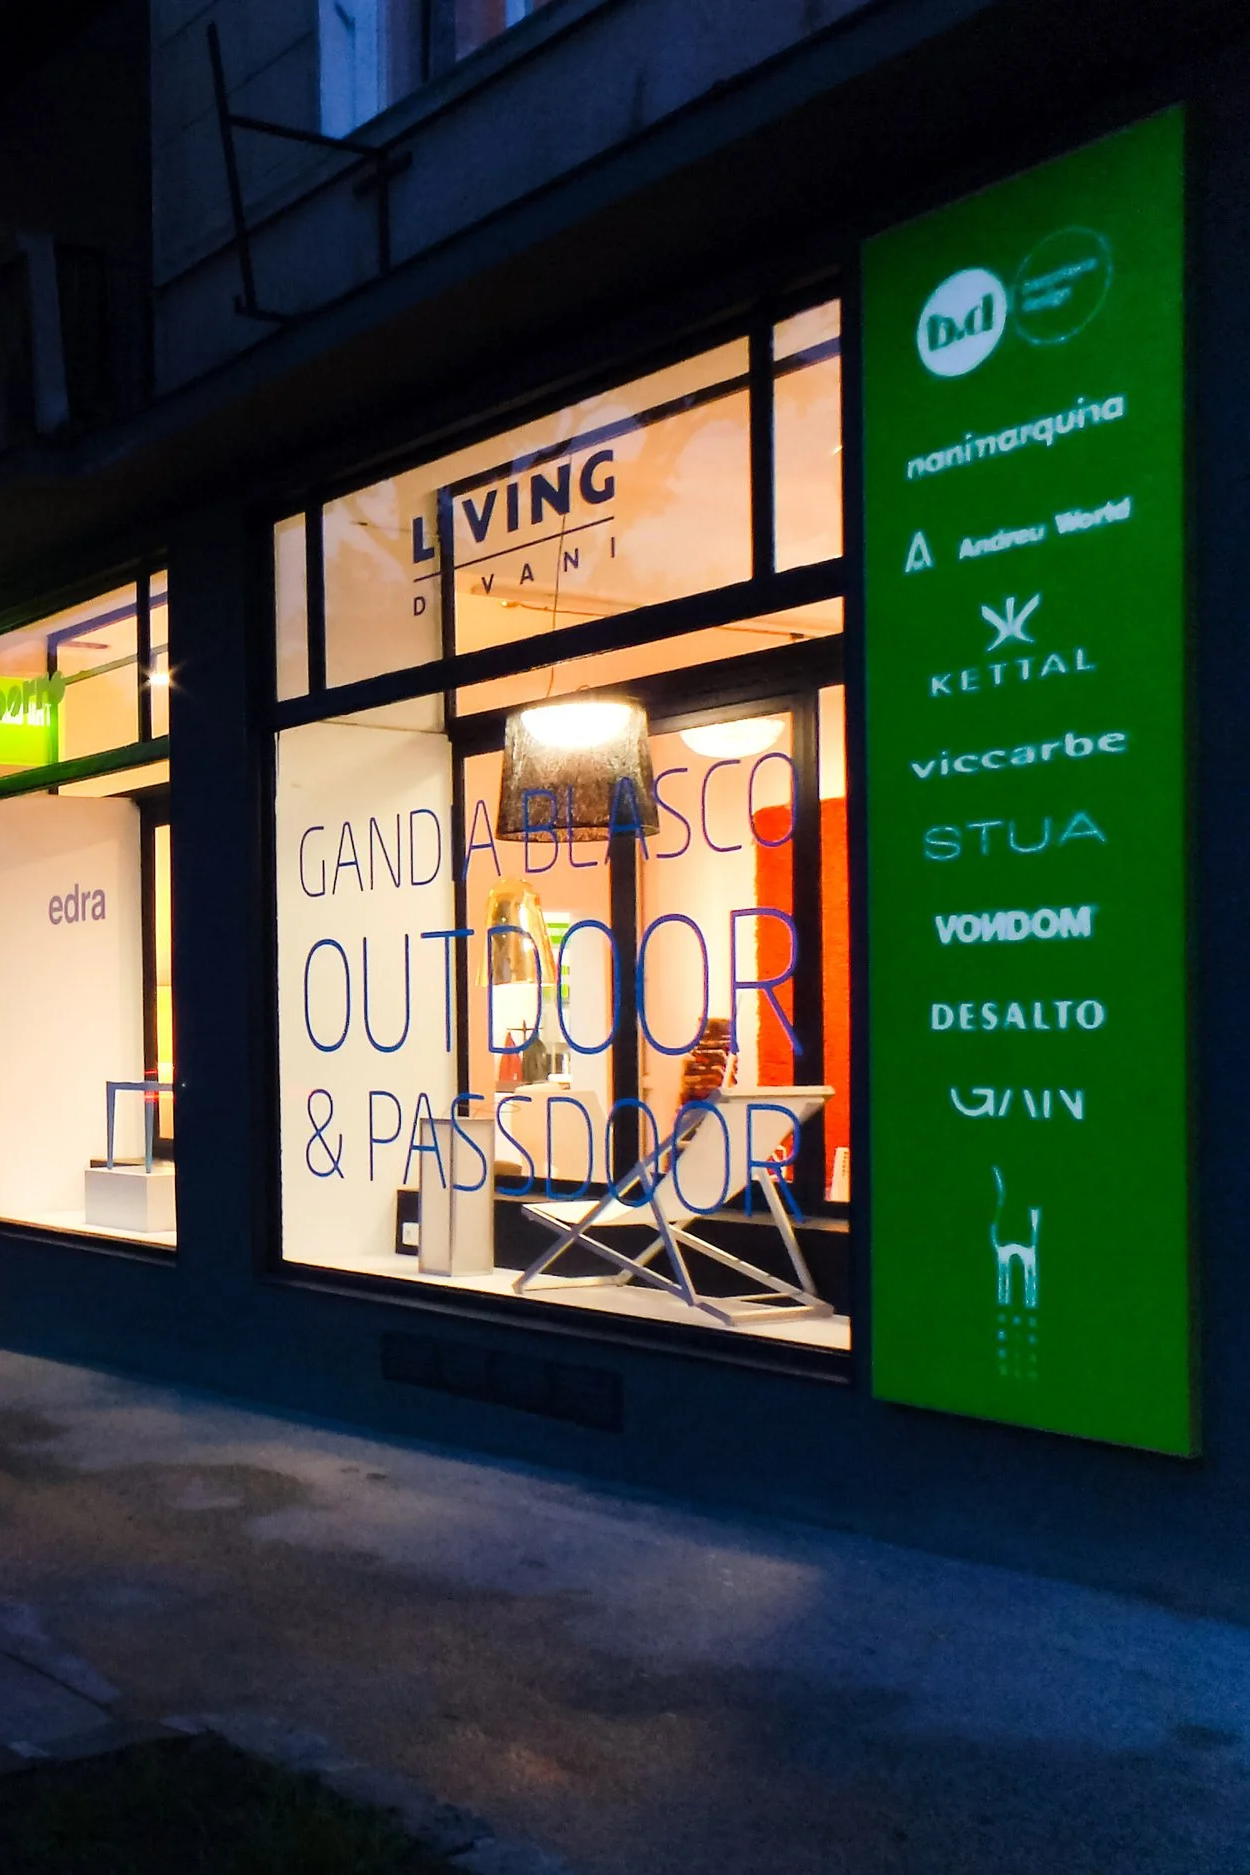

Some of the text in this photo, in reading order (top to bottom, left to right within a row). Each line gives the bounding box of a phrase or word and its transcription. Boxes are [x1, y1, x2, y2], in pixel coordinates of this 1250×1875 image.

[930, 648, 1096, 696] KETTAL
[911, 732, 1127, 779] viccarbe
[520, 752, 800, 874] BLASCO
[924, 811, 1106, 861] STUA
[49, 883, 105, 925] edra
[303, 907, 803, 1057] OUTDOOR
[931, 1000, 1105, 1030] DESALTO
[305, 1088, 805, 1223] & PASSDOOR
